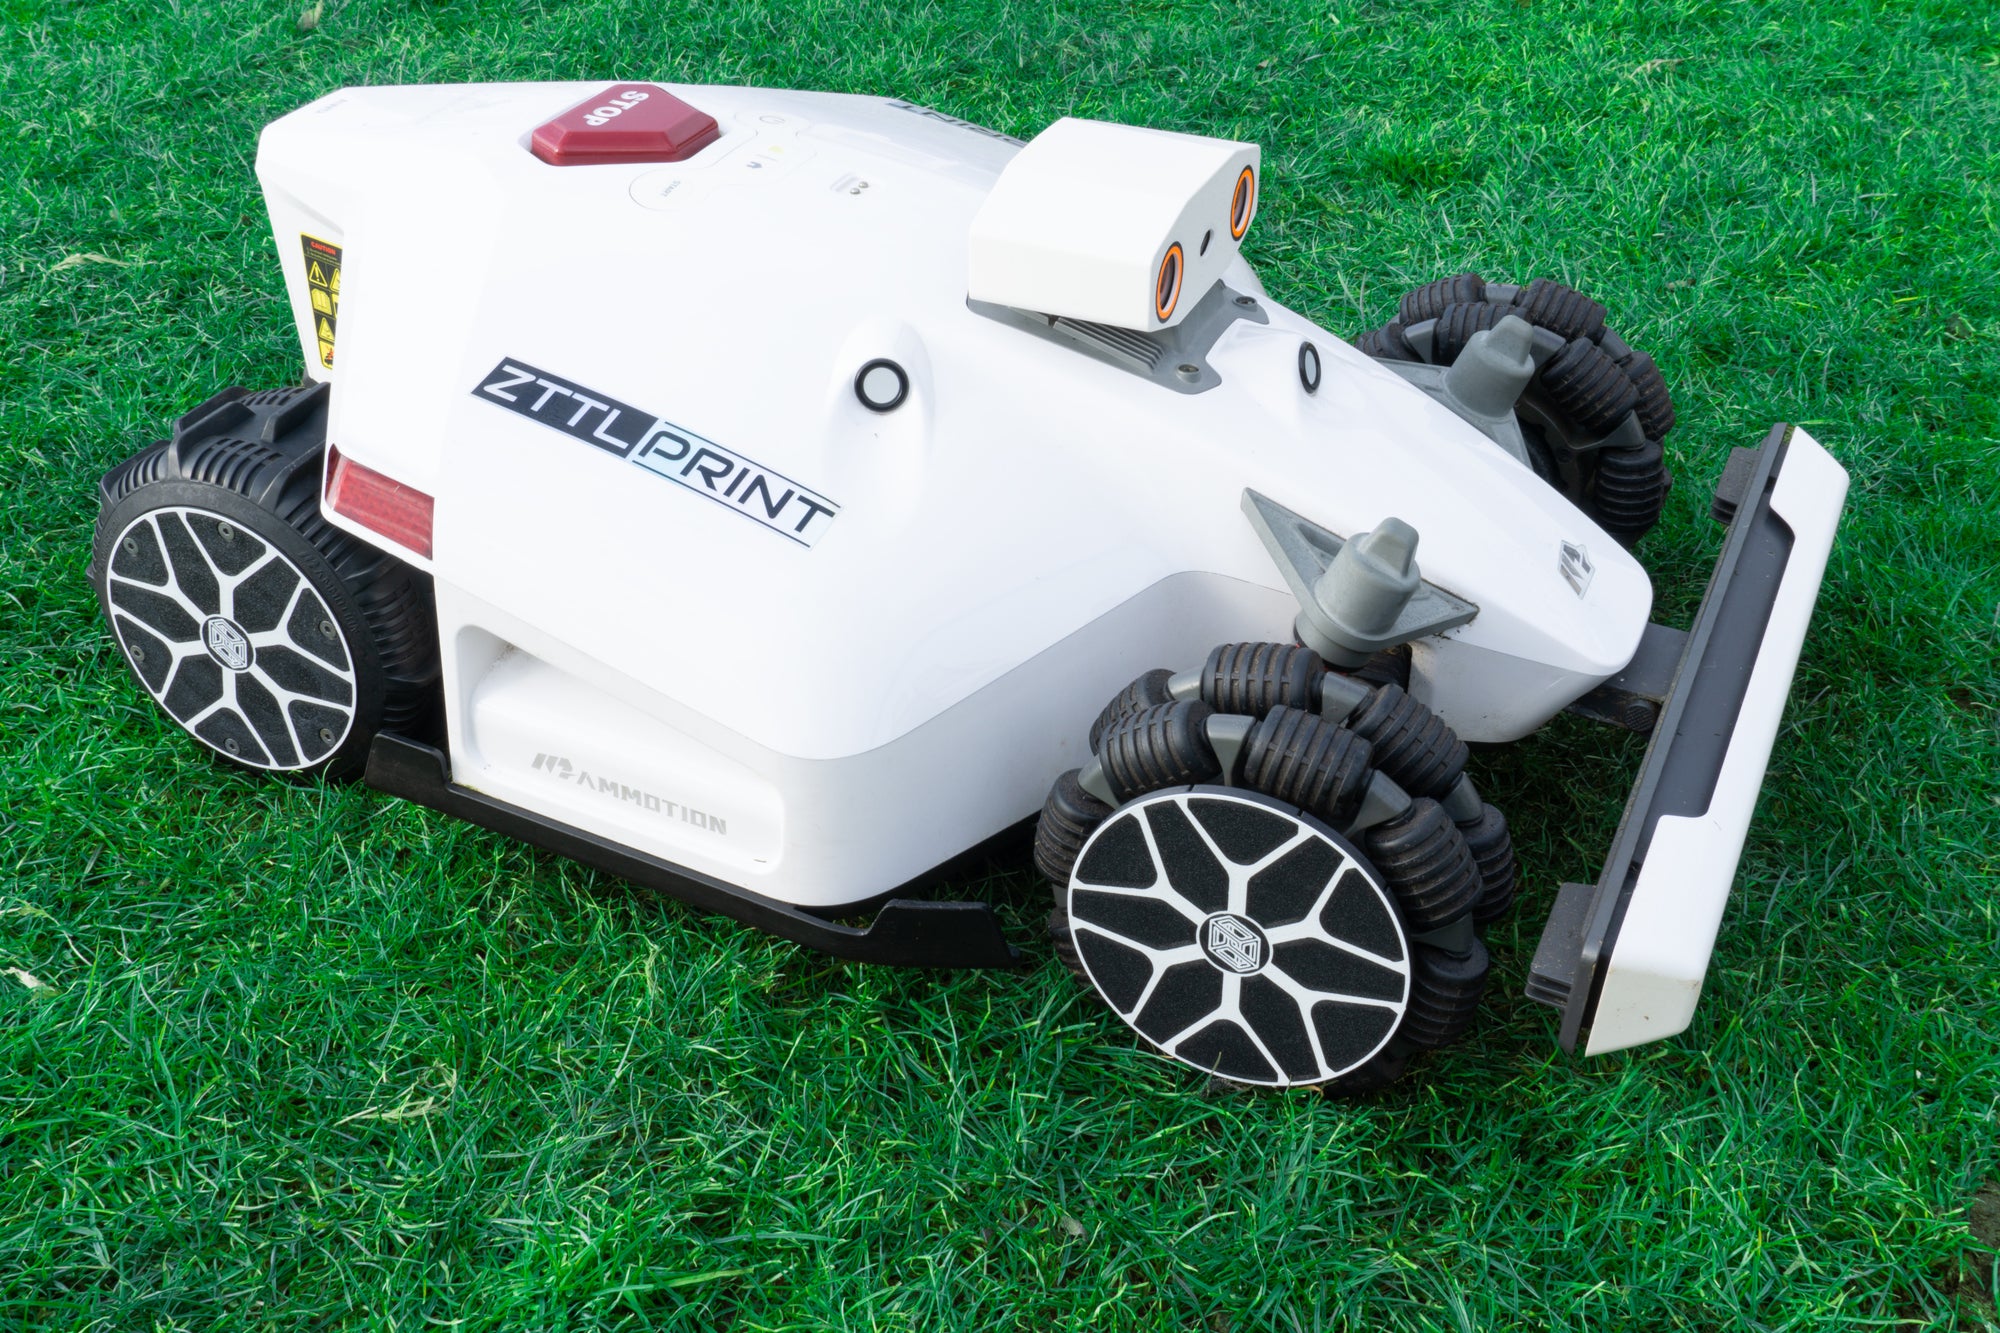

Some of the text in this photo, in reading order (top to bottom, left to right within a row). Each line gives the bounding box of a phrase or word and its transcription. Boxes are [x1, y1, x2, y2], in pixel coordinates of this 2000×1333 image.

[583, 90, 650, 127] STOP
[310, 240, 337, 256] CAUTION
[483, 364, 836, 534] ZTTL PRINT
